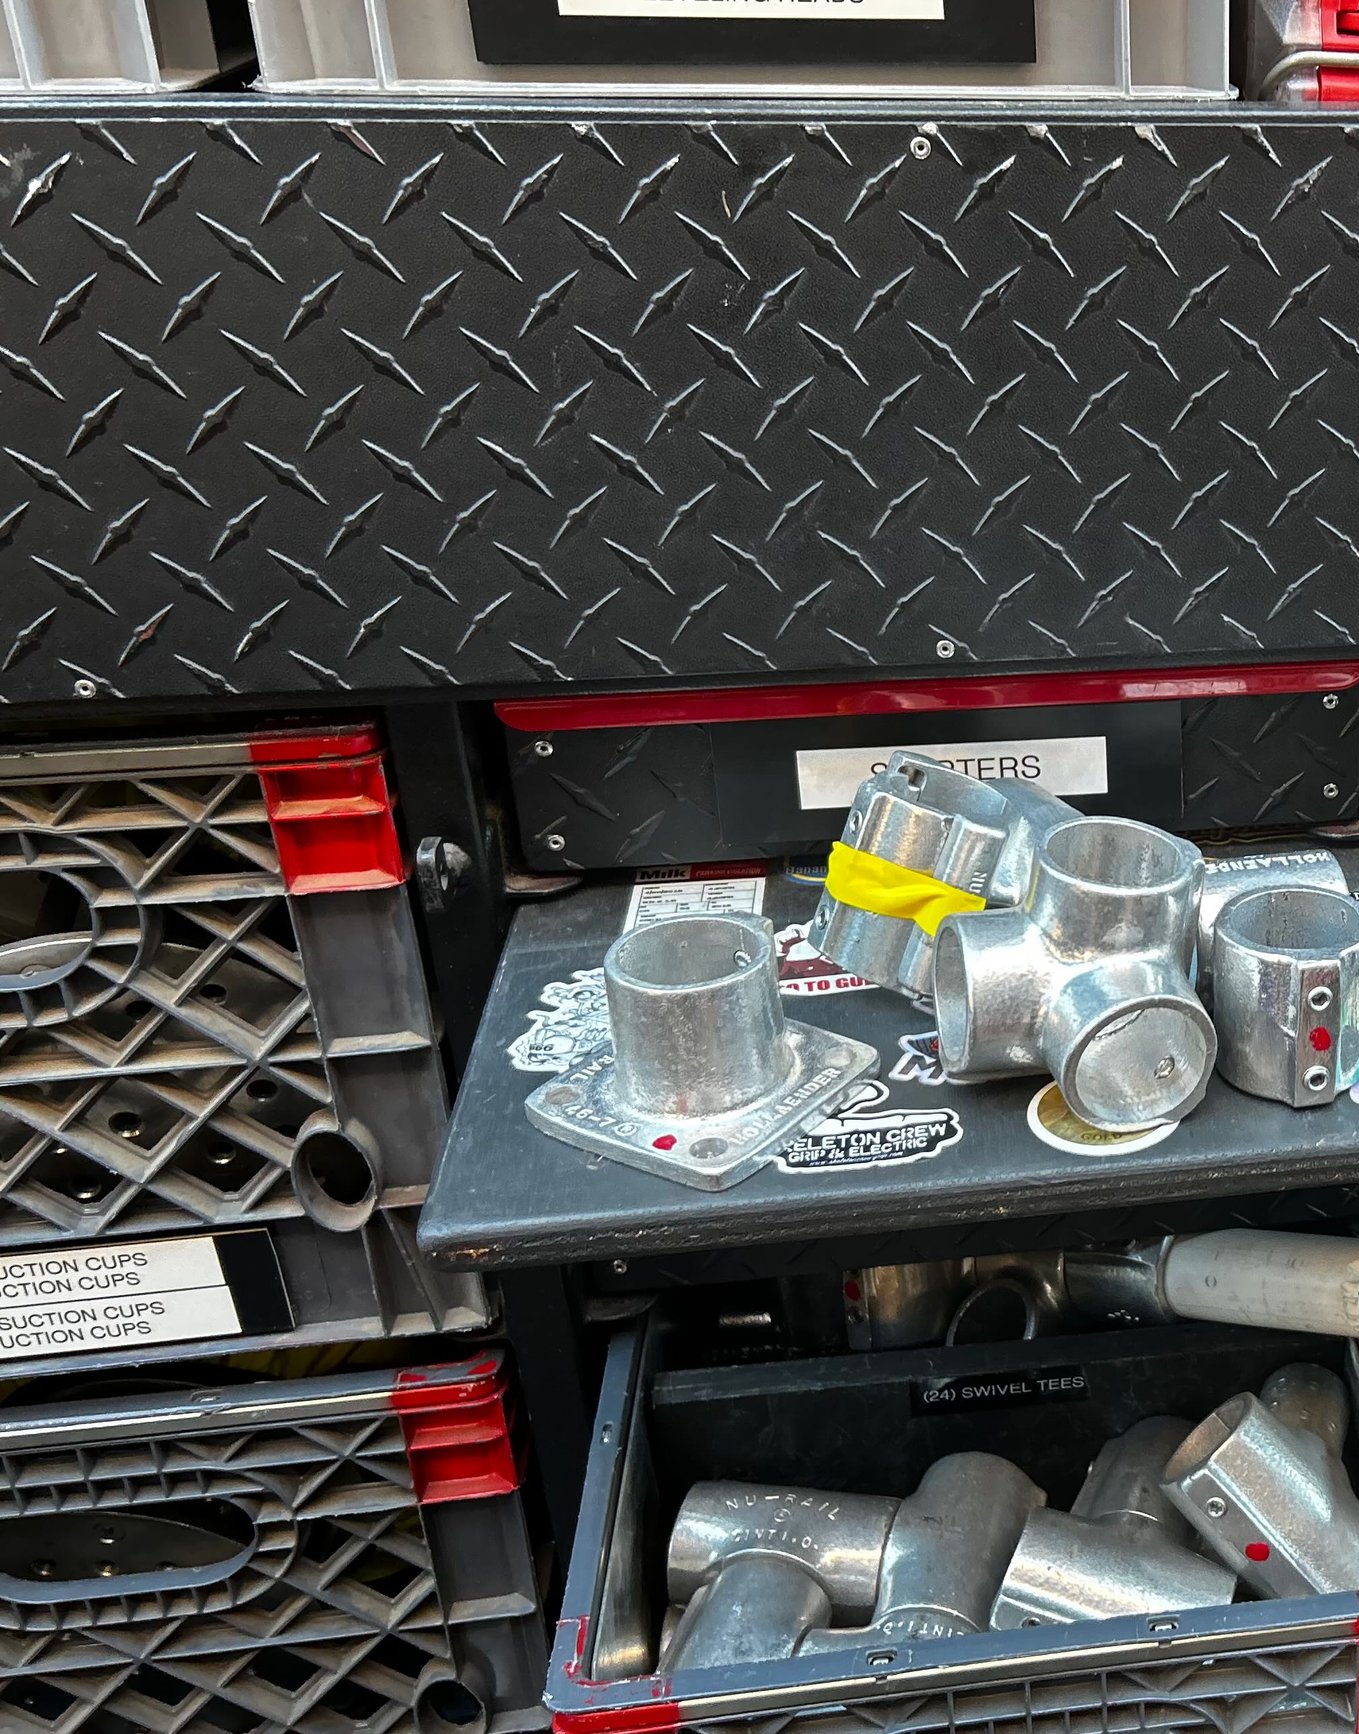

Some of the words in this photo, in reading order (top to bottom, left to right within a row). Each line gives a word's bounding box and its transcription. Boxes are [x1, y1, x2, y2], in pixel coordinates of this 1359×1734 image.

[639, 868, 687, 880] Milk
[804, 980, 831, 992] TO
[885, 1122, 947, 1143] CREW
[787, 1150, 827, 1163] GRIP
[828, 1148, 845, 1160] &
[848, 1136, 928, 1158] ELECTRIC
[85, 1251, 149, 1272] CUPS
[0, 1278, 73, 1299] CTION
[78, 1271, 142, 1291] CUPS
[0, 1308, 98, 1332] SUCTION
[103, 1300, 166, 1321] CUPS
[90, 1320, 153, 1341] CUPS
[923, 1388, 956, 1403] (24)
[961, 1381, 1033, 1399] SWIVEL
[1036, 1376, 1085, 1392] TEES
